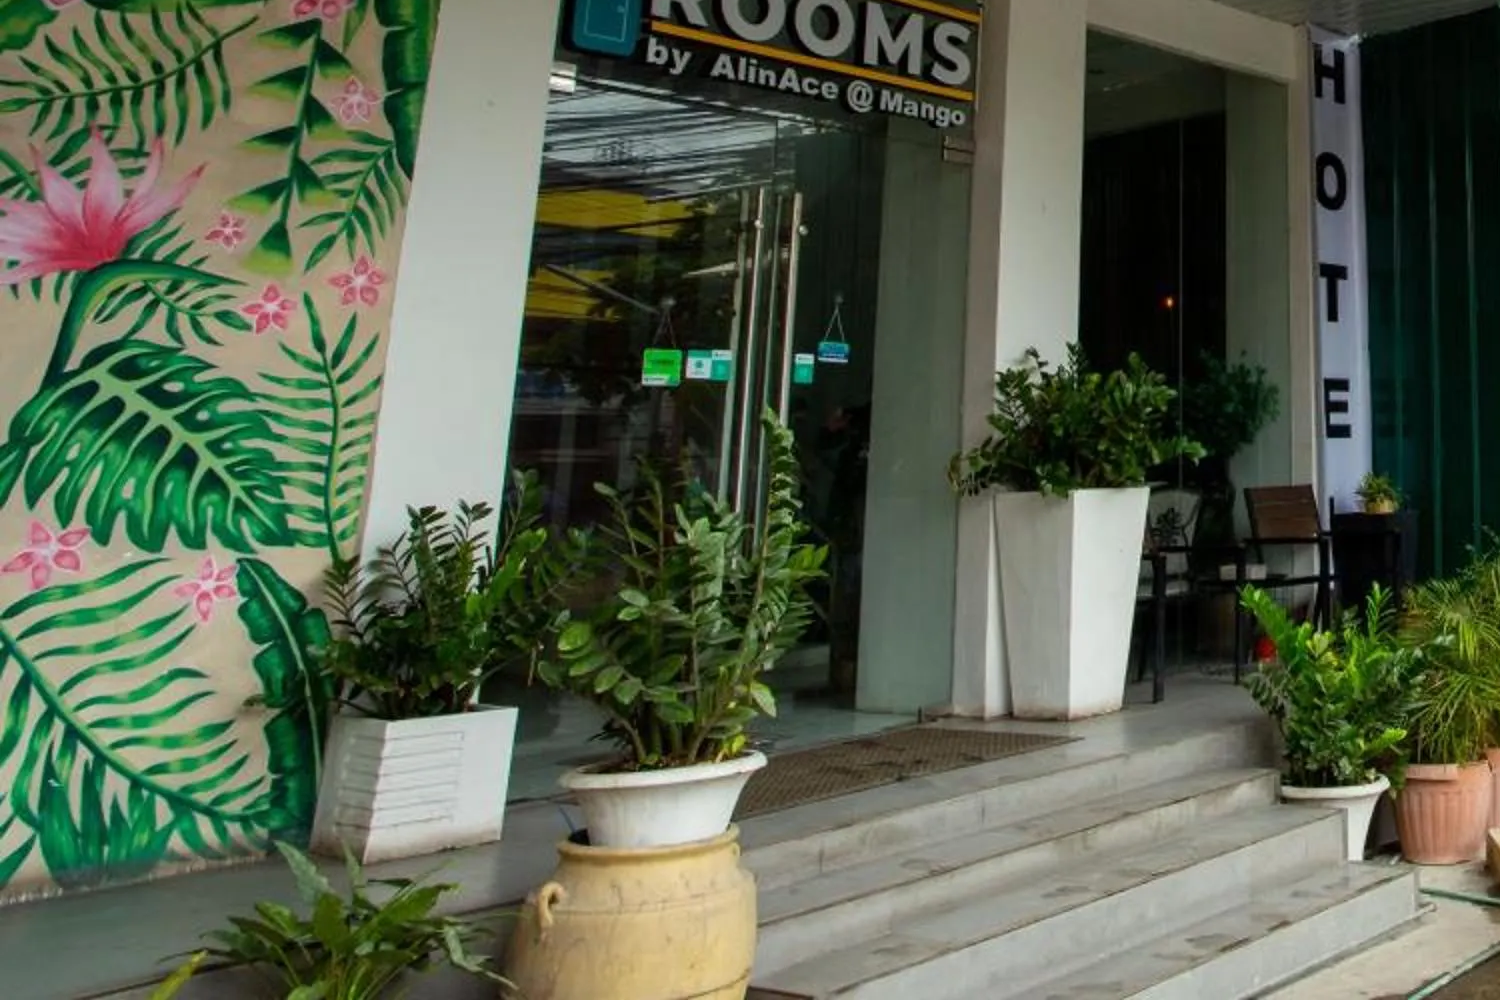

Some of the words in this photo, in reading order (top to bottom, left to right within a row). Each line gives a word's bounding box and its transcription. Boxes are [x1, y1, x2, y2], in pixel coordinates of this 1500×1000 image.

[646, 35, 692, 76] by
[711, 54, 838, 100] AlinAce
[846, 79, 876, 113] @
[880, 89, 966, 127] Mango
